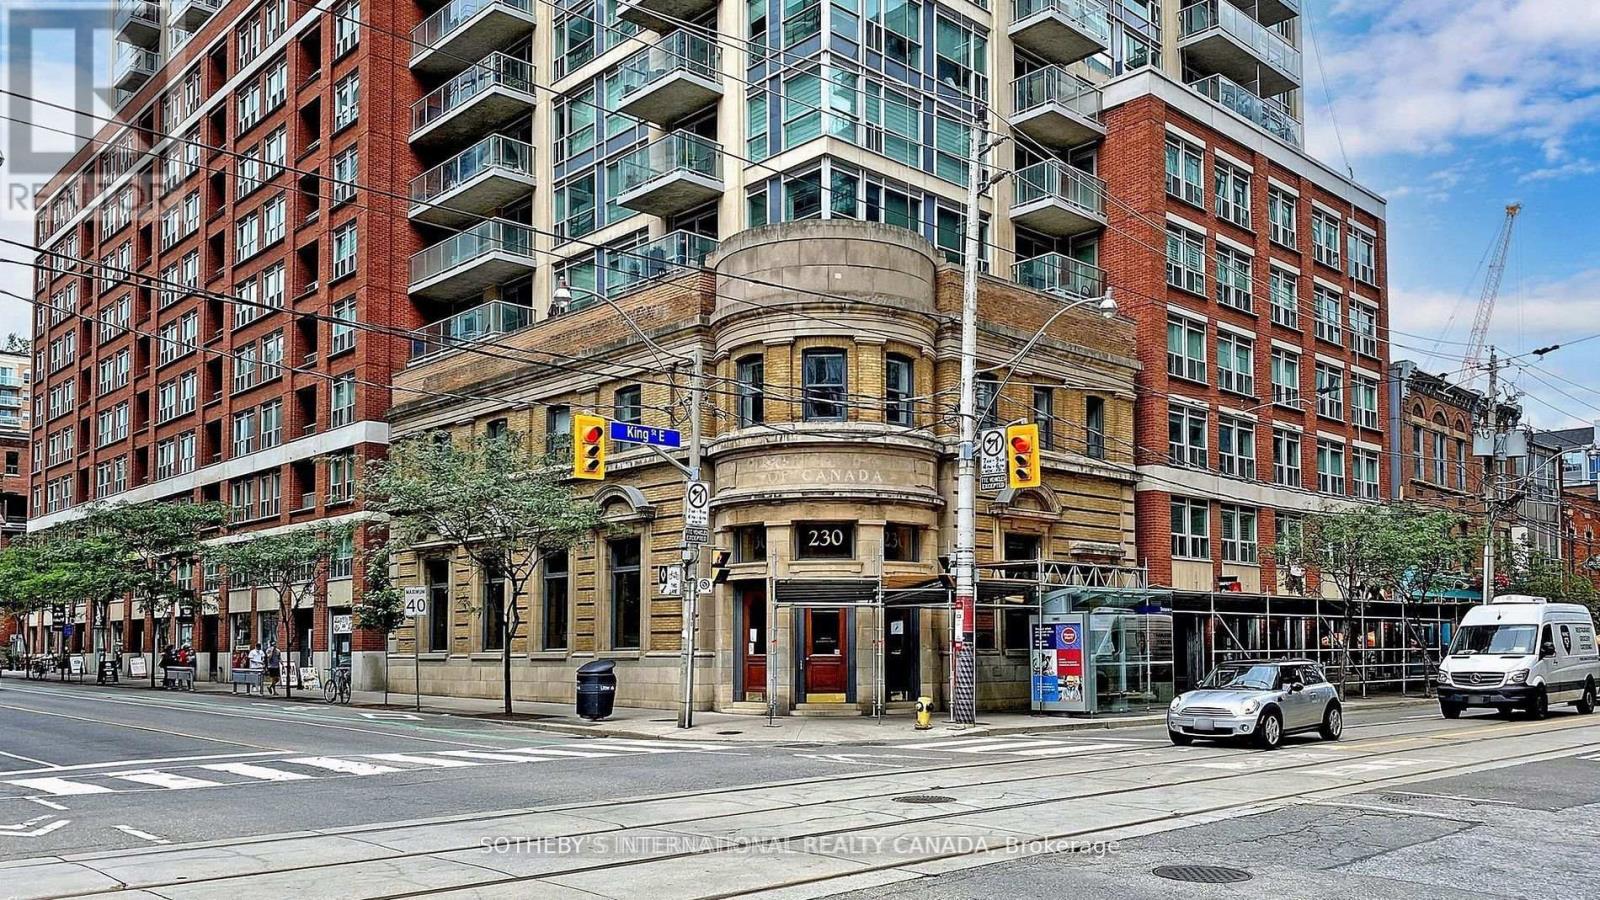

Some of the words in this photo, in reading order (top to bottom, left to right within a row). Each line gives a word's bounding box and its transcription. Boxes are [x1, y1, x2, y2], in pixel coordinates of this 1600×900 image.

[626, 425, 649, 443] King
[658, 430, 665, 442] E
[801, 469, 883, 482] CANADA
[808, 530, 843, 546] 230
[406, 598, 426, 613] 40
